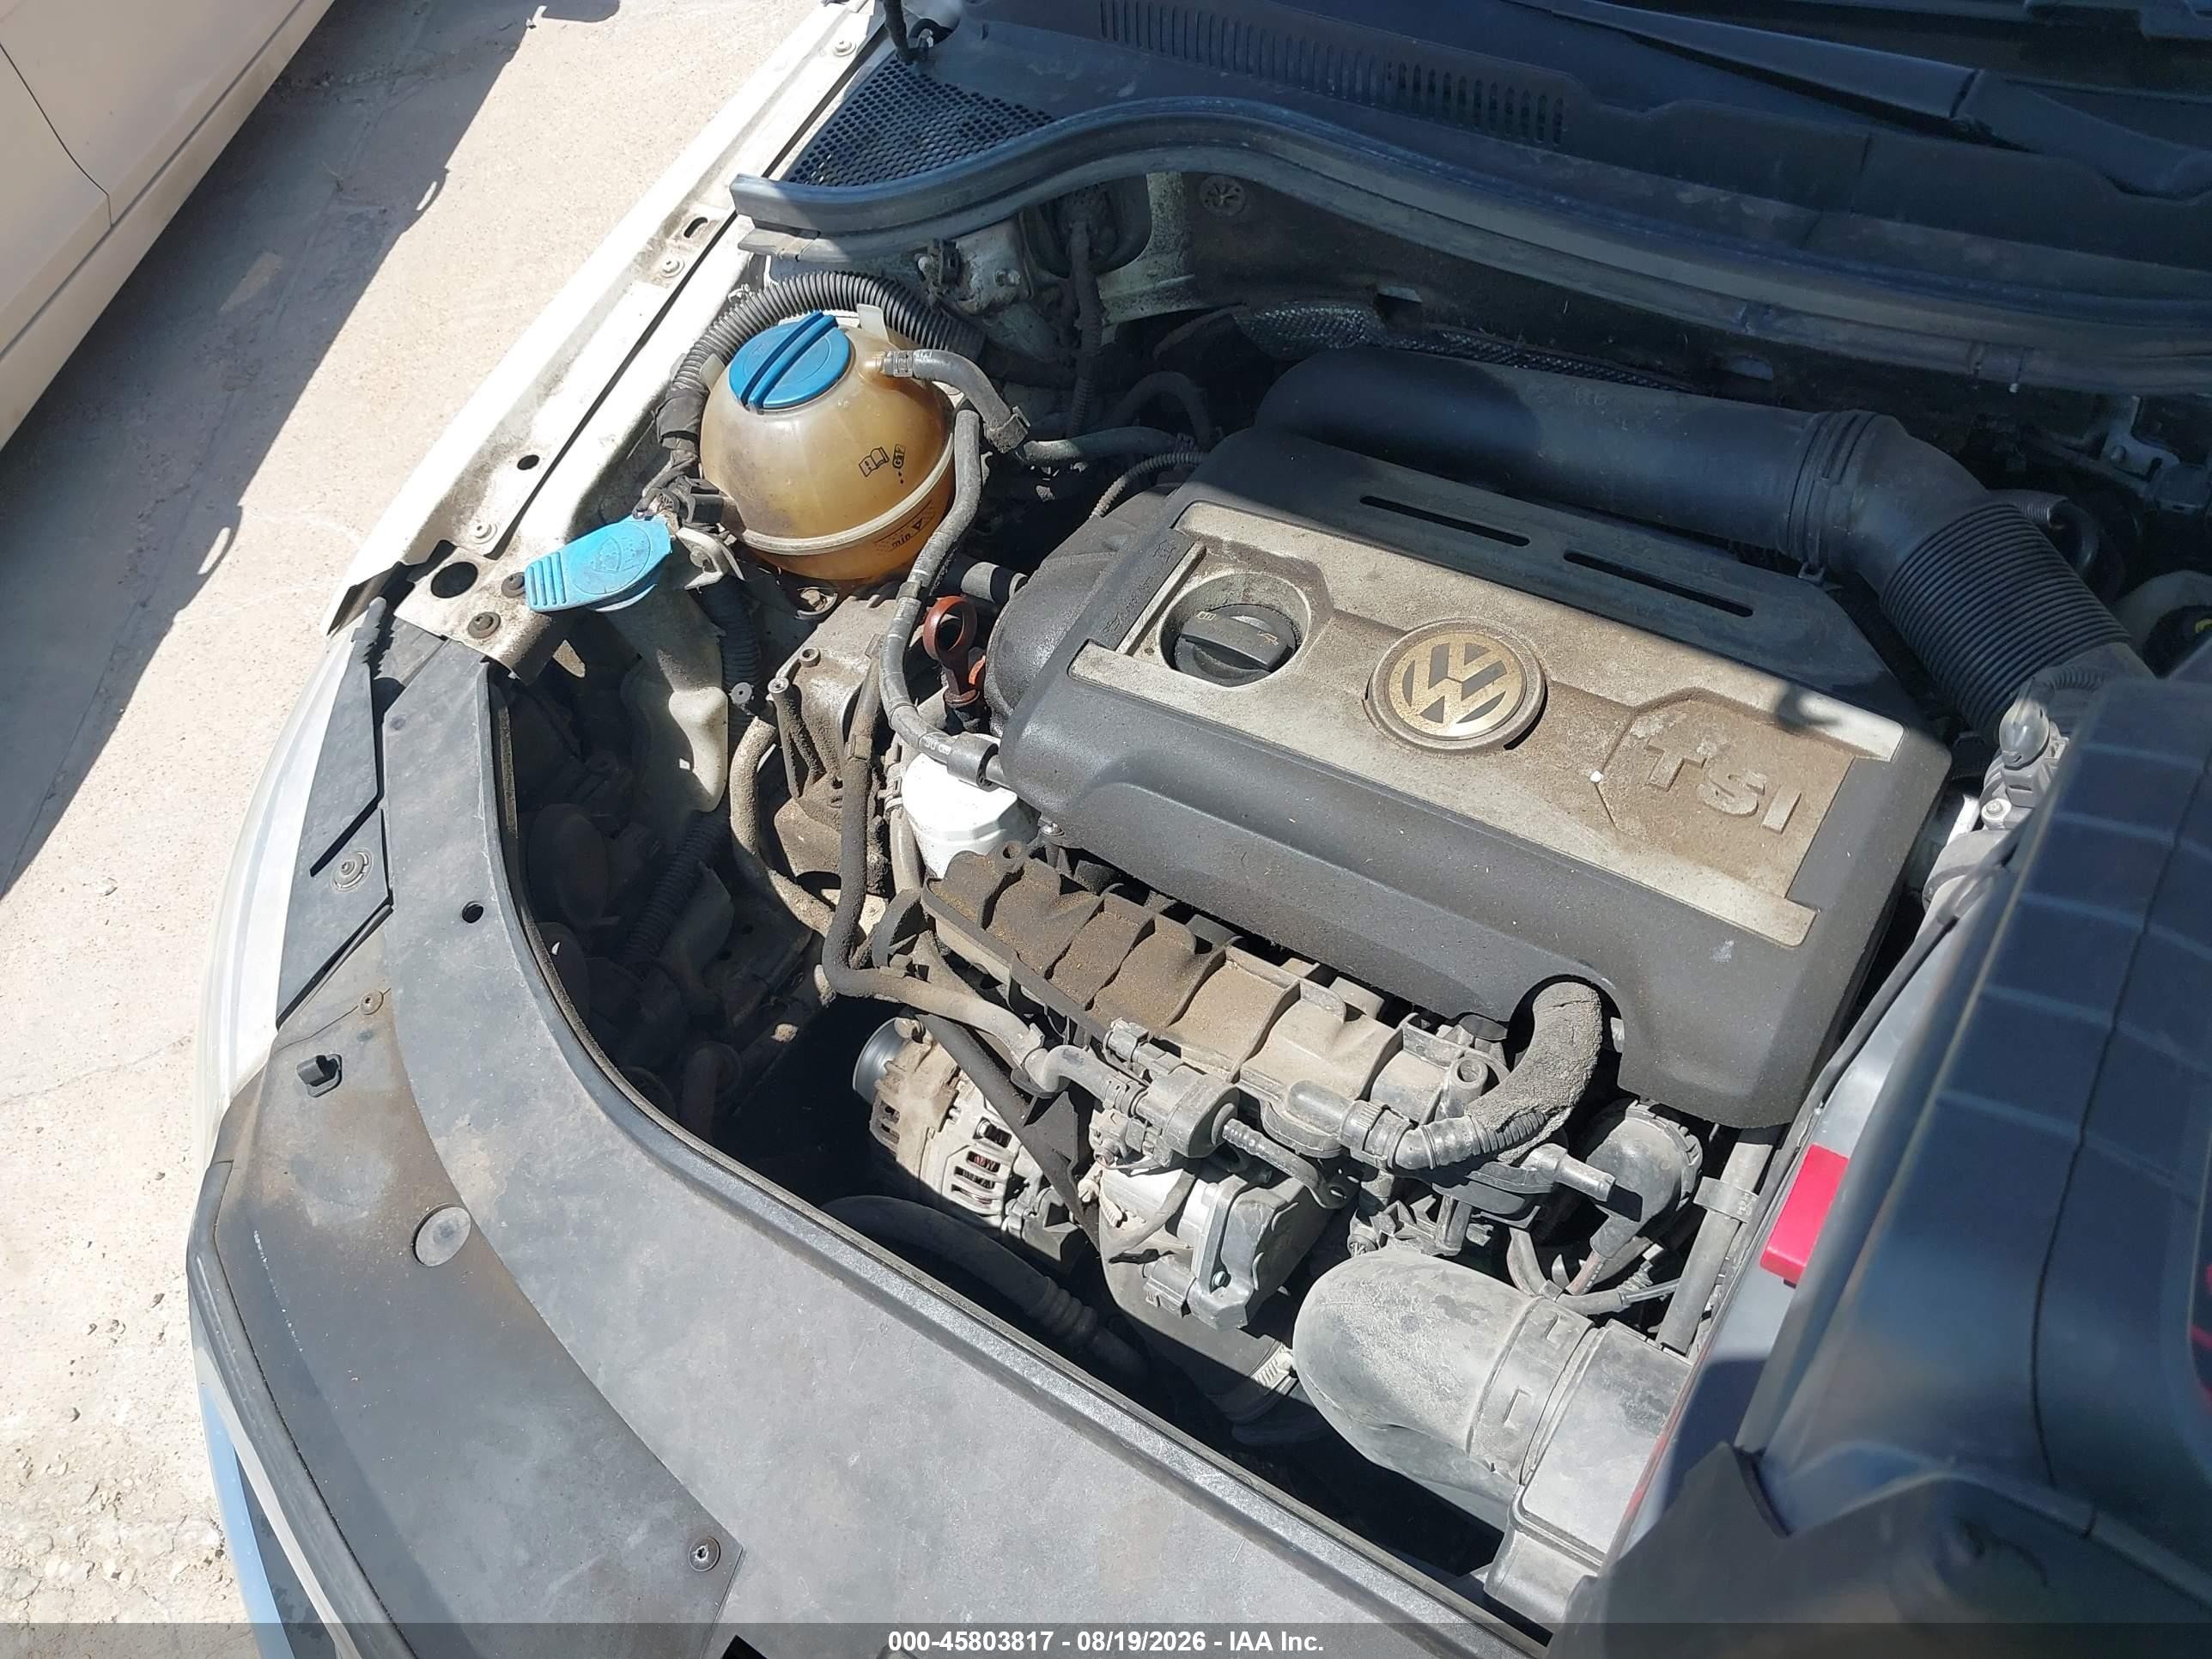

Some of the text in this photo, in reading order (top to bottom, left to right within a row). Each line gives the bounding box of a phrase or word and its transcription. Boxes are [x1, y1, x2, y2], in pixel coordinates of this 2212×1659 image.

[893, 444, 905, 466] G12
[891, 533, 911, 548] min
[1645, 730, 1802, 835] TSI
